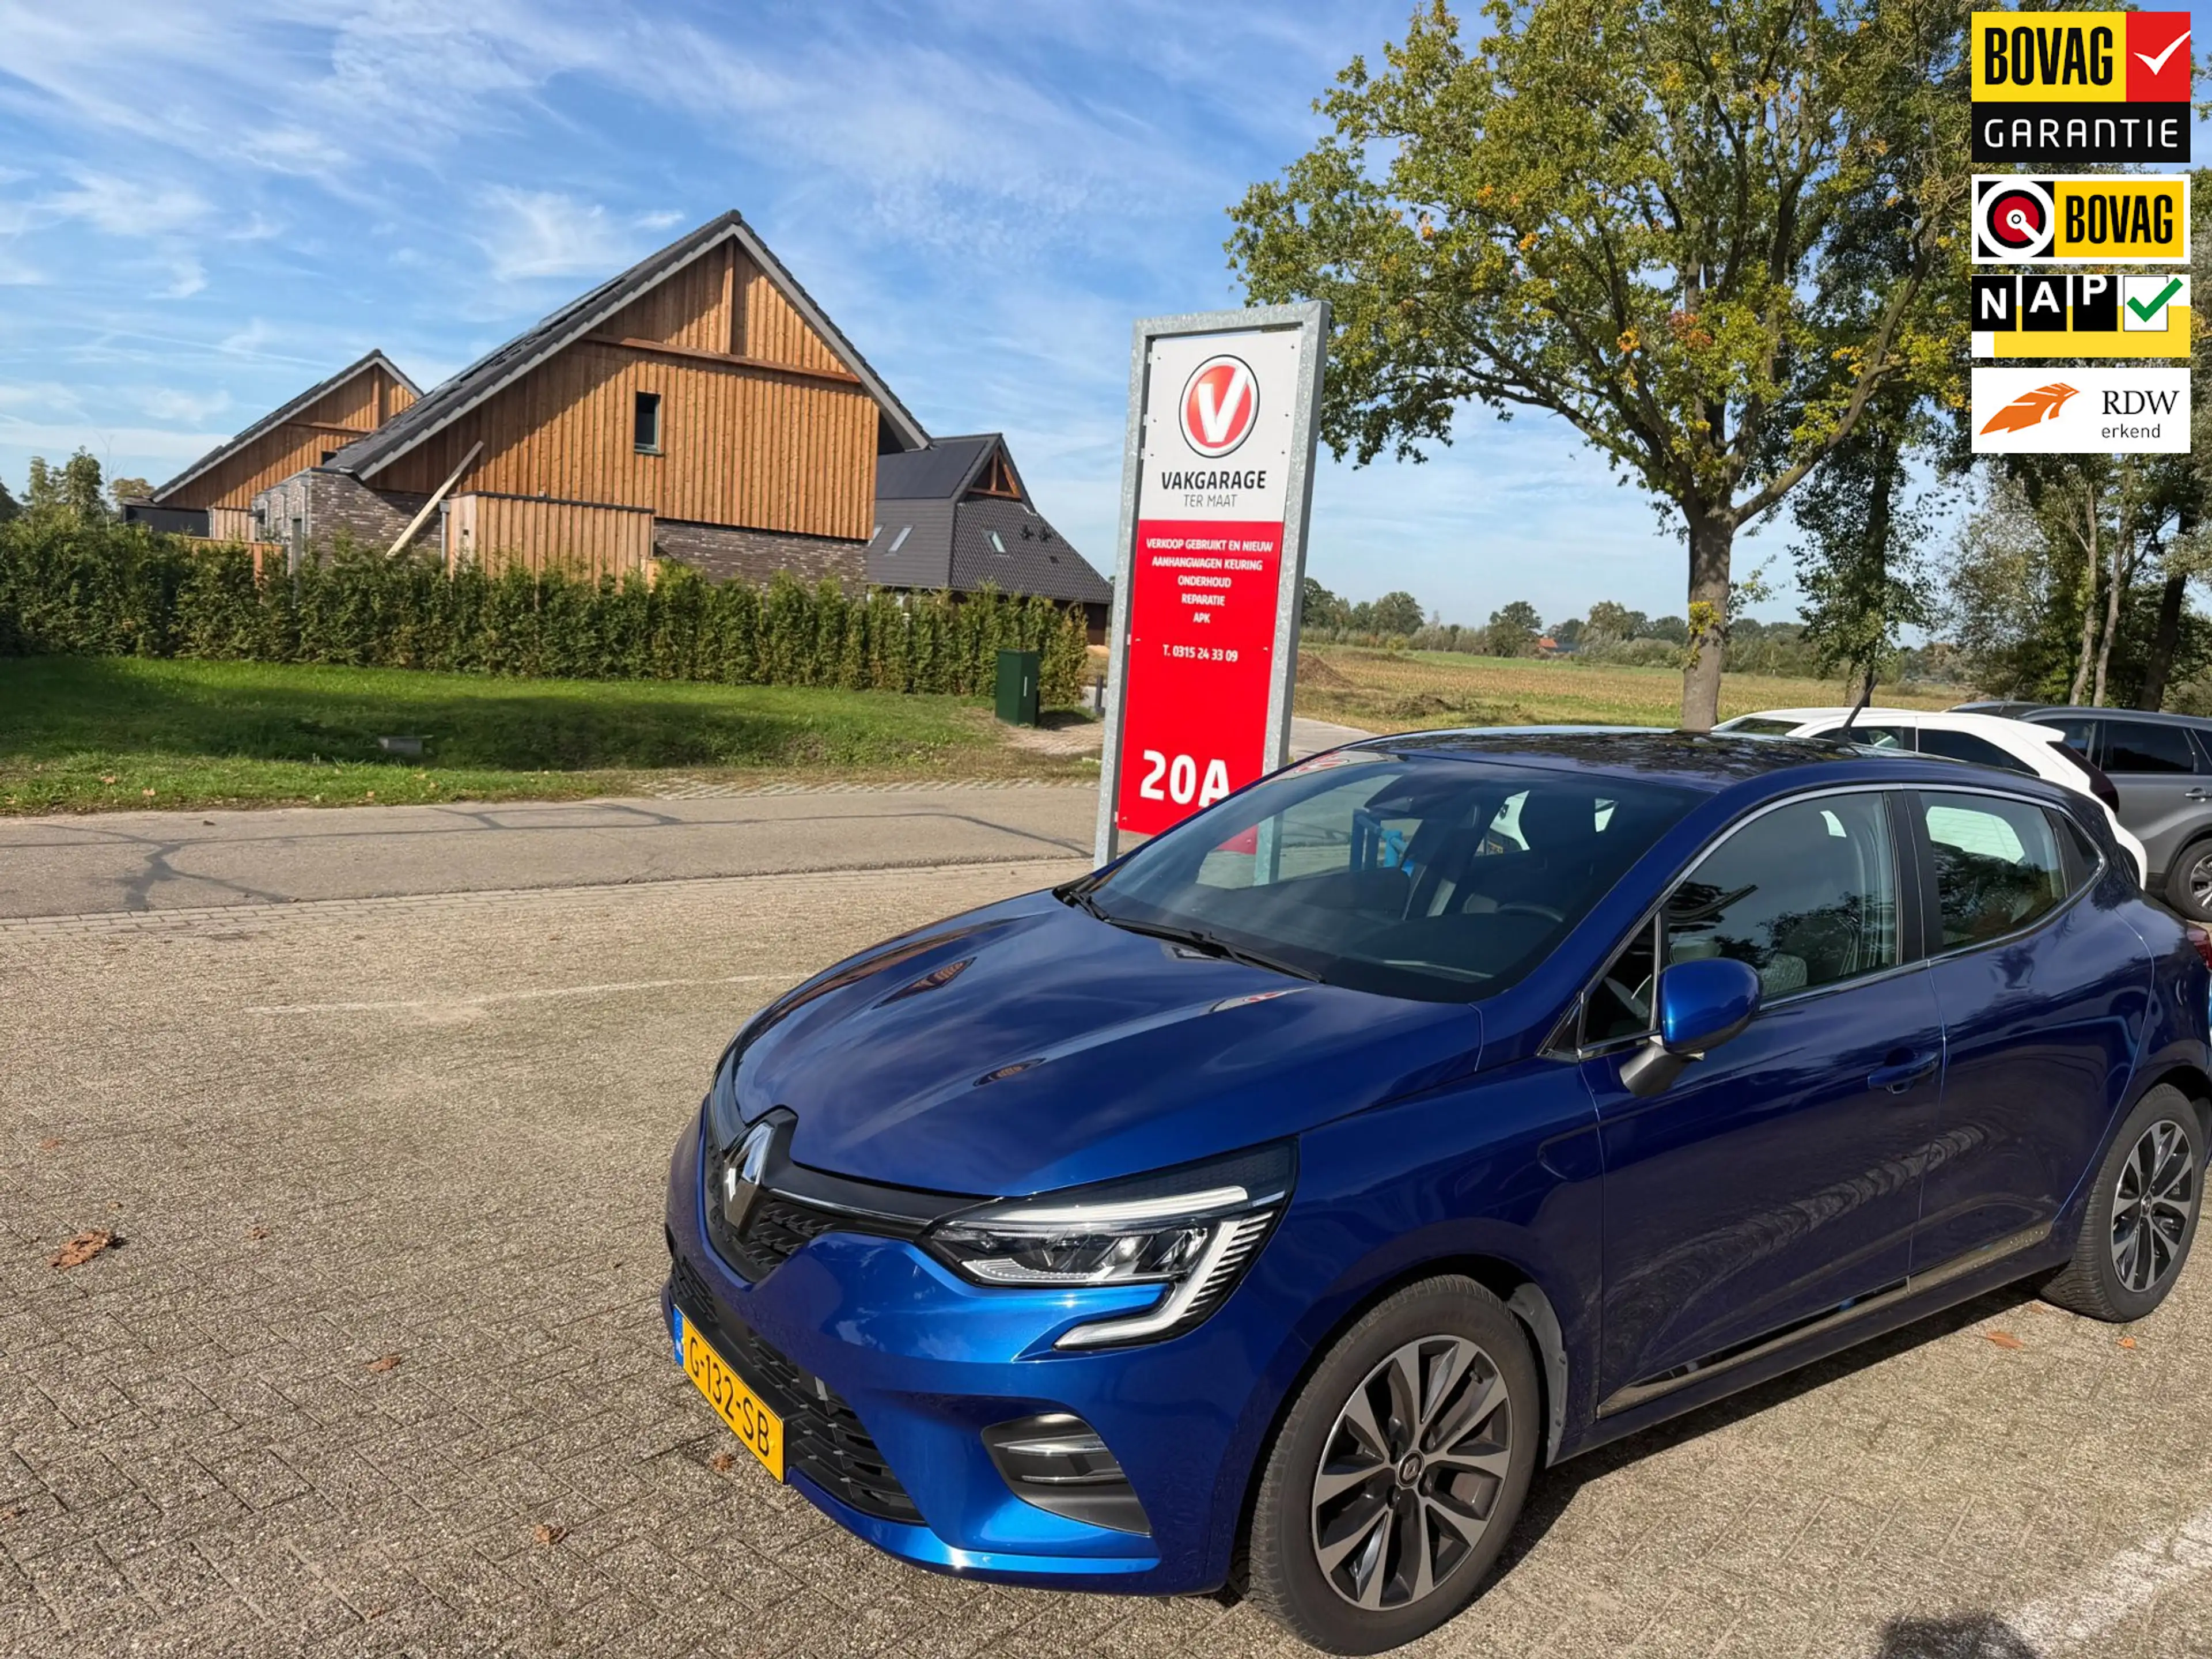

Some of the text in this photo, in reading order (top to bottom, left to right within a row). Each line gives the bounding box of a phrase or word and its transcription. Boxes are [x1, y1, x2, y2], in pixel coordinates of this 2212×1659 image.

[1161, 470, 1267, 490] VAKGARAGE
[1184, 494, 1238, 507] TER MAAT
[1146, 537, 1273, 552] VERKOOP GEBRUIKT EN NIEUW
[1152, 556, 1263, 571] AANHANGWAGEN KEURING
[1177, 575, 1232, 588] ONDERHOUD
[1181, 593, 1225, 606] REPARATIE
[1193, 612, 1211, 623] APK
[1162, 644, 1238, 662] T. 0315 24 33 09
[1139, 749, 1230, 808] 20A
[690, 1336, 769, 1457] G-132-SB
